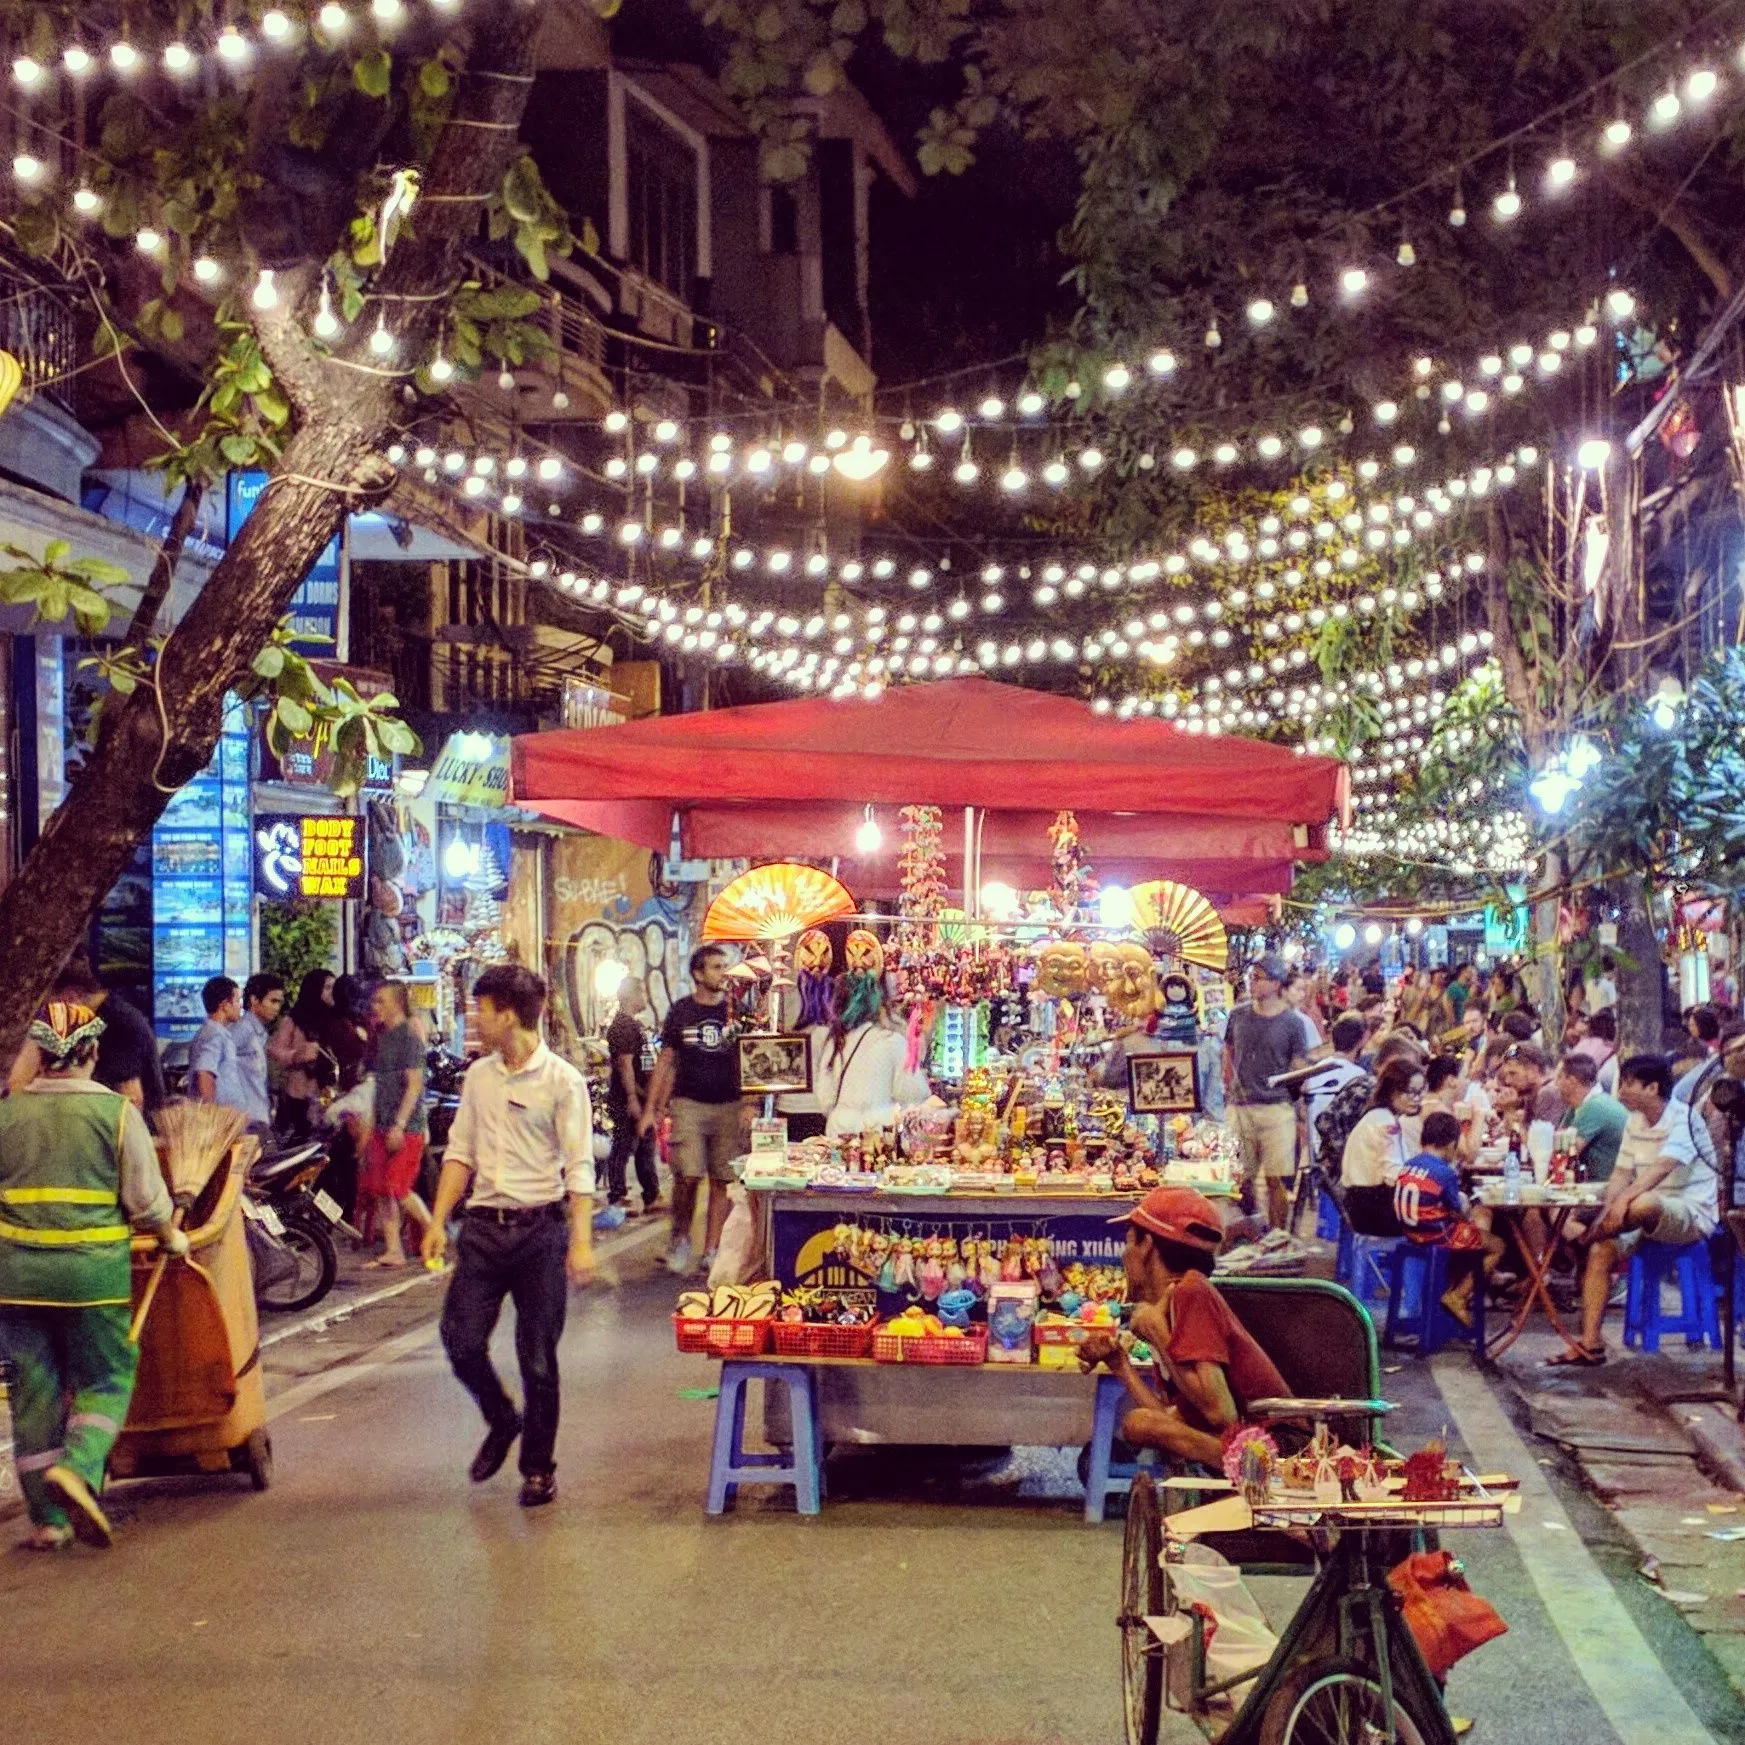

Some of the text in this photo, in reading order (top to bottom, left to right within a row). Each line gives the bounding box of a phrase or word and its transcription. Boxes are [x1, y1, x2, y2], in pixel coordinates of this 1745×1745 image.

[303, 819, 355, 838] BODY
[302, 838, 352, 857] FOOT
[302, 858, 361, 877] NAILS
[301, 876, 348, 896] WAX
[1394, 1182, 1419, 1226] 10
